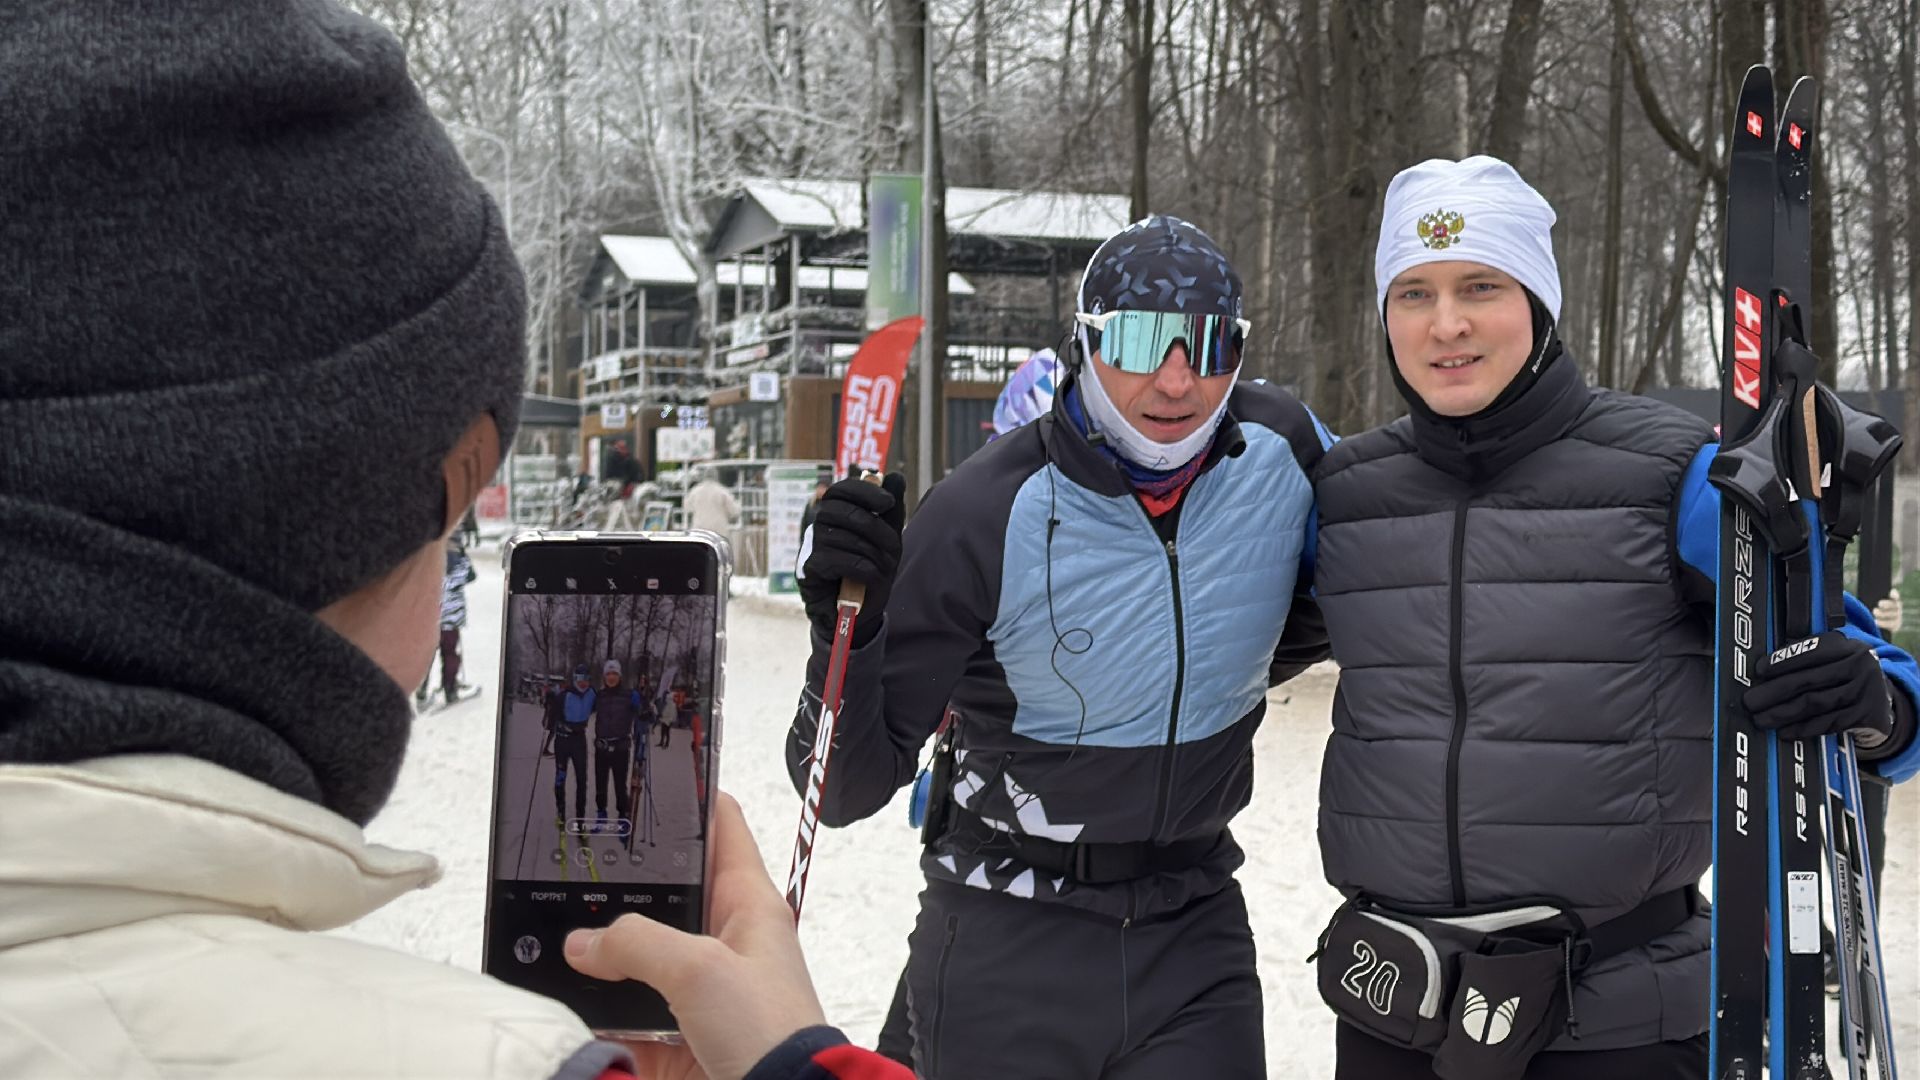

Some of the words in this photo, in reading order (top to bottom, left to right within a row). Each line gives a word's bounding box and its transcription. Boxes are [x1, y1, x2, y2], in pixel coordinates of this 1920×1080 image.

[1771, 637, 1819, 665] KV+
[1736, 785, 1748, 836] RS
[1795, 791, 1807, 843] RS
[531, 891, 567, 902] ПОРТРЕТ
[583, 893, 608, 903] ФОТО
[623, 894, 652, 904] ВИДЕО
[1341, 940, 1400, 1015] 20
